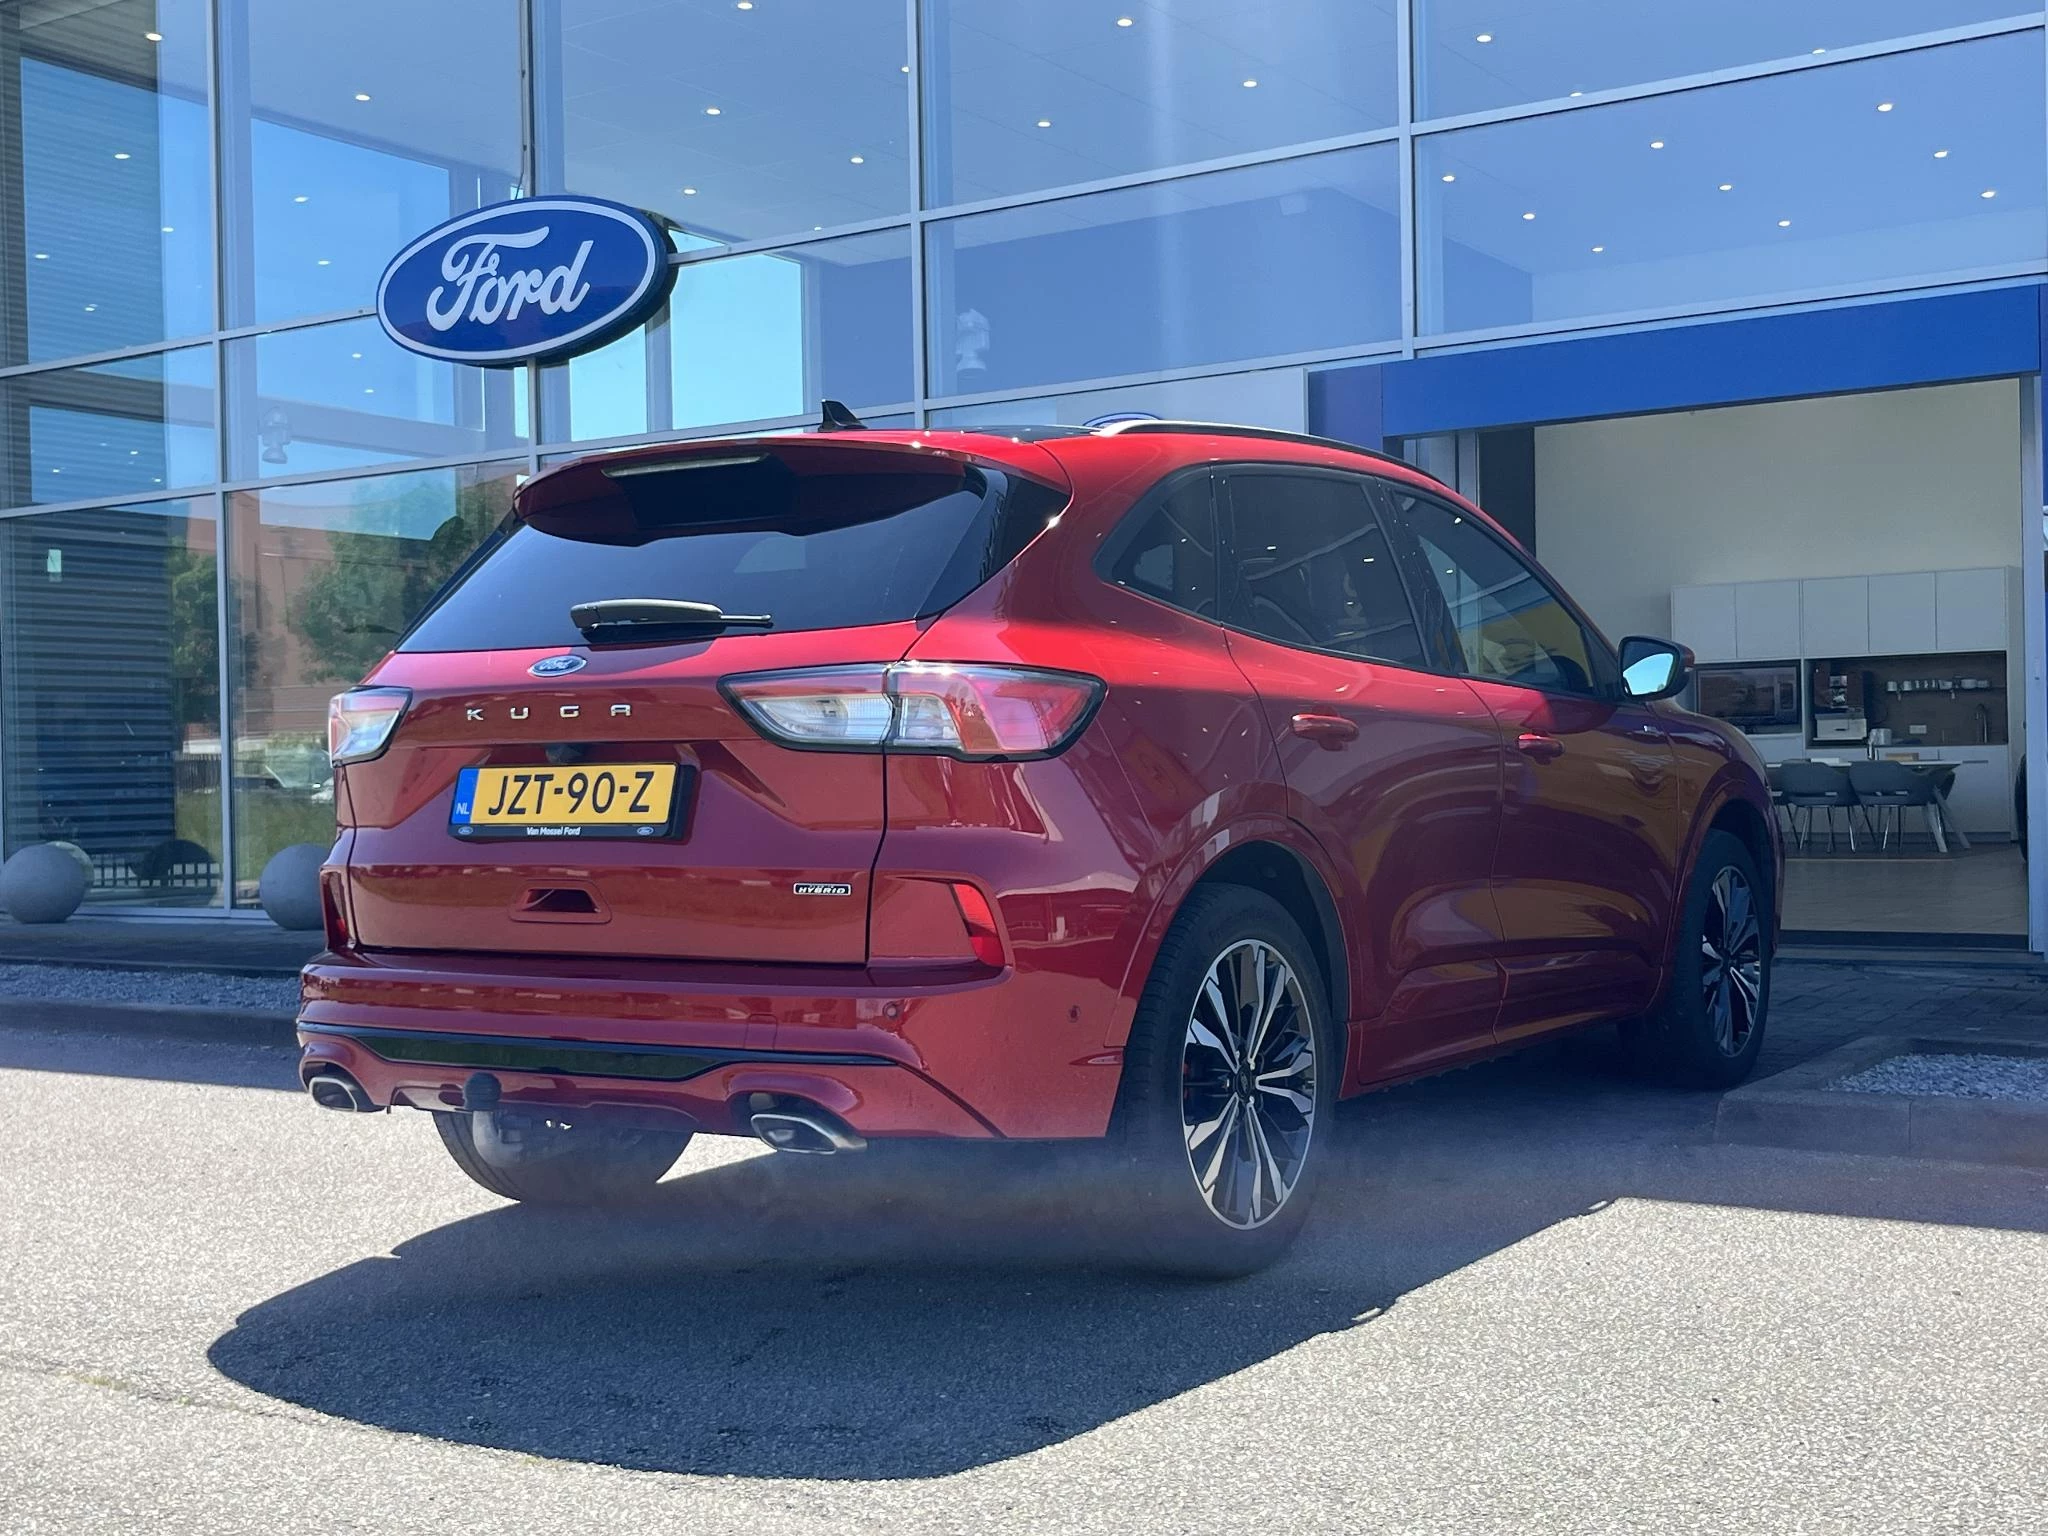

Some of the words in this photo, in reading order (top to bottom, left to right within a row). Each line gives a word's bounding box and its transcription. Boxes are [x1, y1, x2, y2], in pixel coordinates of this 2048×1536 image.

[426, 226, 594, 332] Ford
[467, 704, 632, 721] KUGA
[488, 771, 655, 816] JZT-90-Z
[456, 802, 470, 815] NL
[527, 826, 539, 836] Van
[564, 826, 581, 836] Ford
[798, 886, 846, 894] HYBRID
